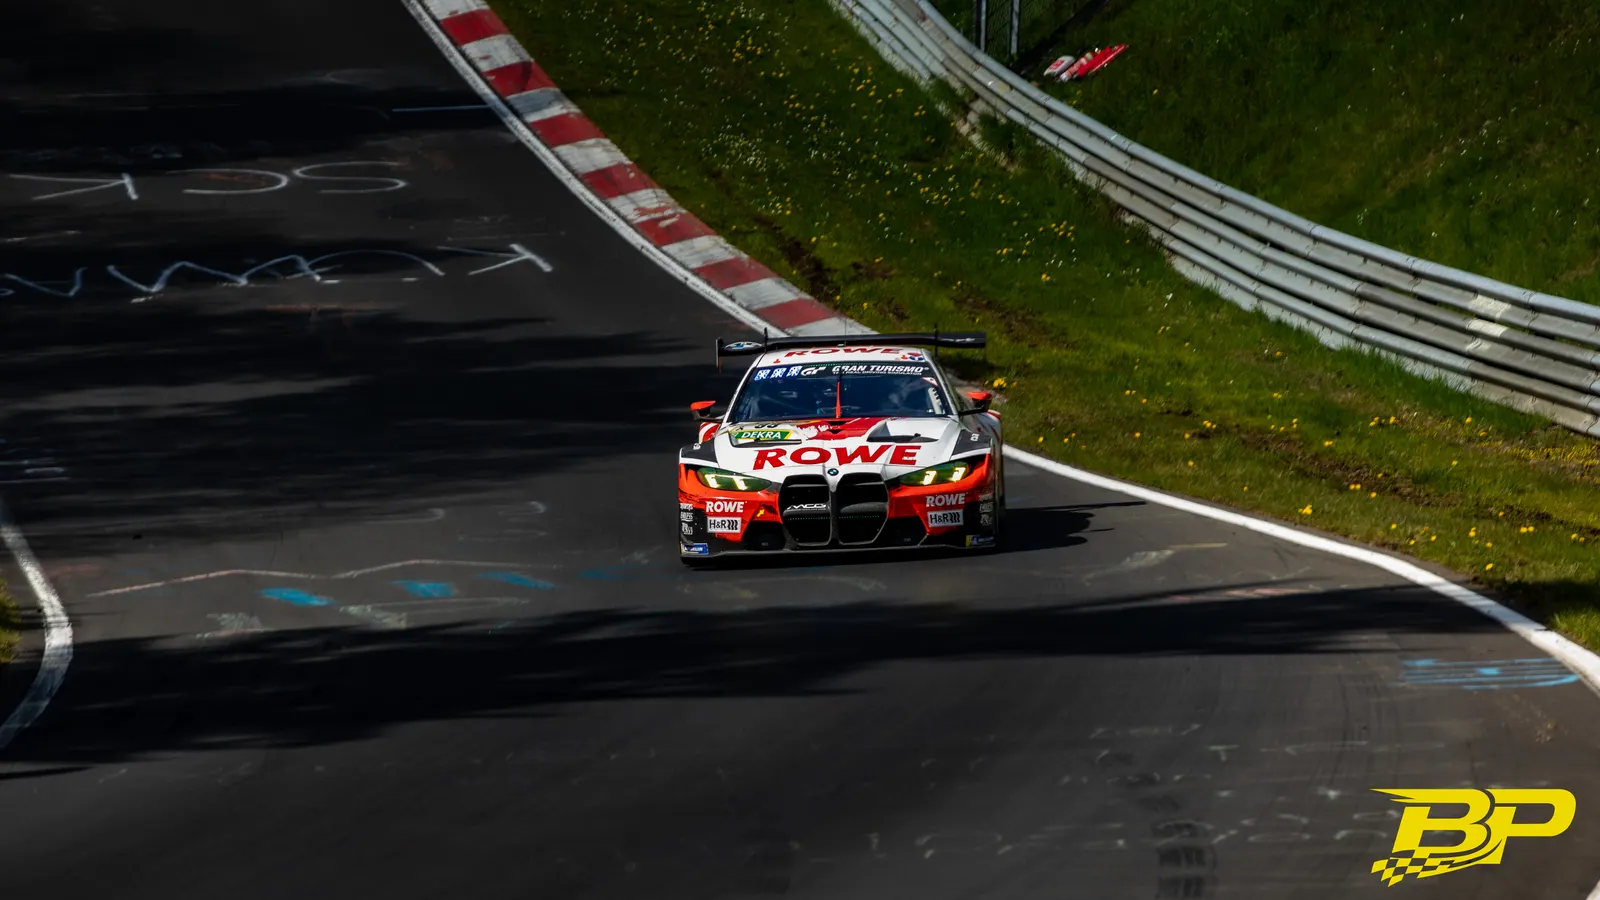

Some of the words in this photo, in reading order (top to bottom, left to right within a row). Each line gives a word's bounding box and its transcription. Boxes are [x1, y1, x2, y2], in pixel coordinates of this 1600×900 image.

[784, 347, 903, 357] ROWE
[832, 365, 867, 373] GRAN
[870, 365, 924, 373] TURISMO
[741, 431, 781, 439] DEKRA
[753, 445, 921, 470] ROWE
[925, 493, 966, 508] ROWE
[705, 500, 745, 513] ROWE
[709, 518, 727, 529] H&R
[930, 512, 949, 524] H&R
